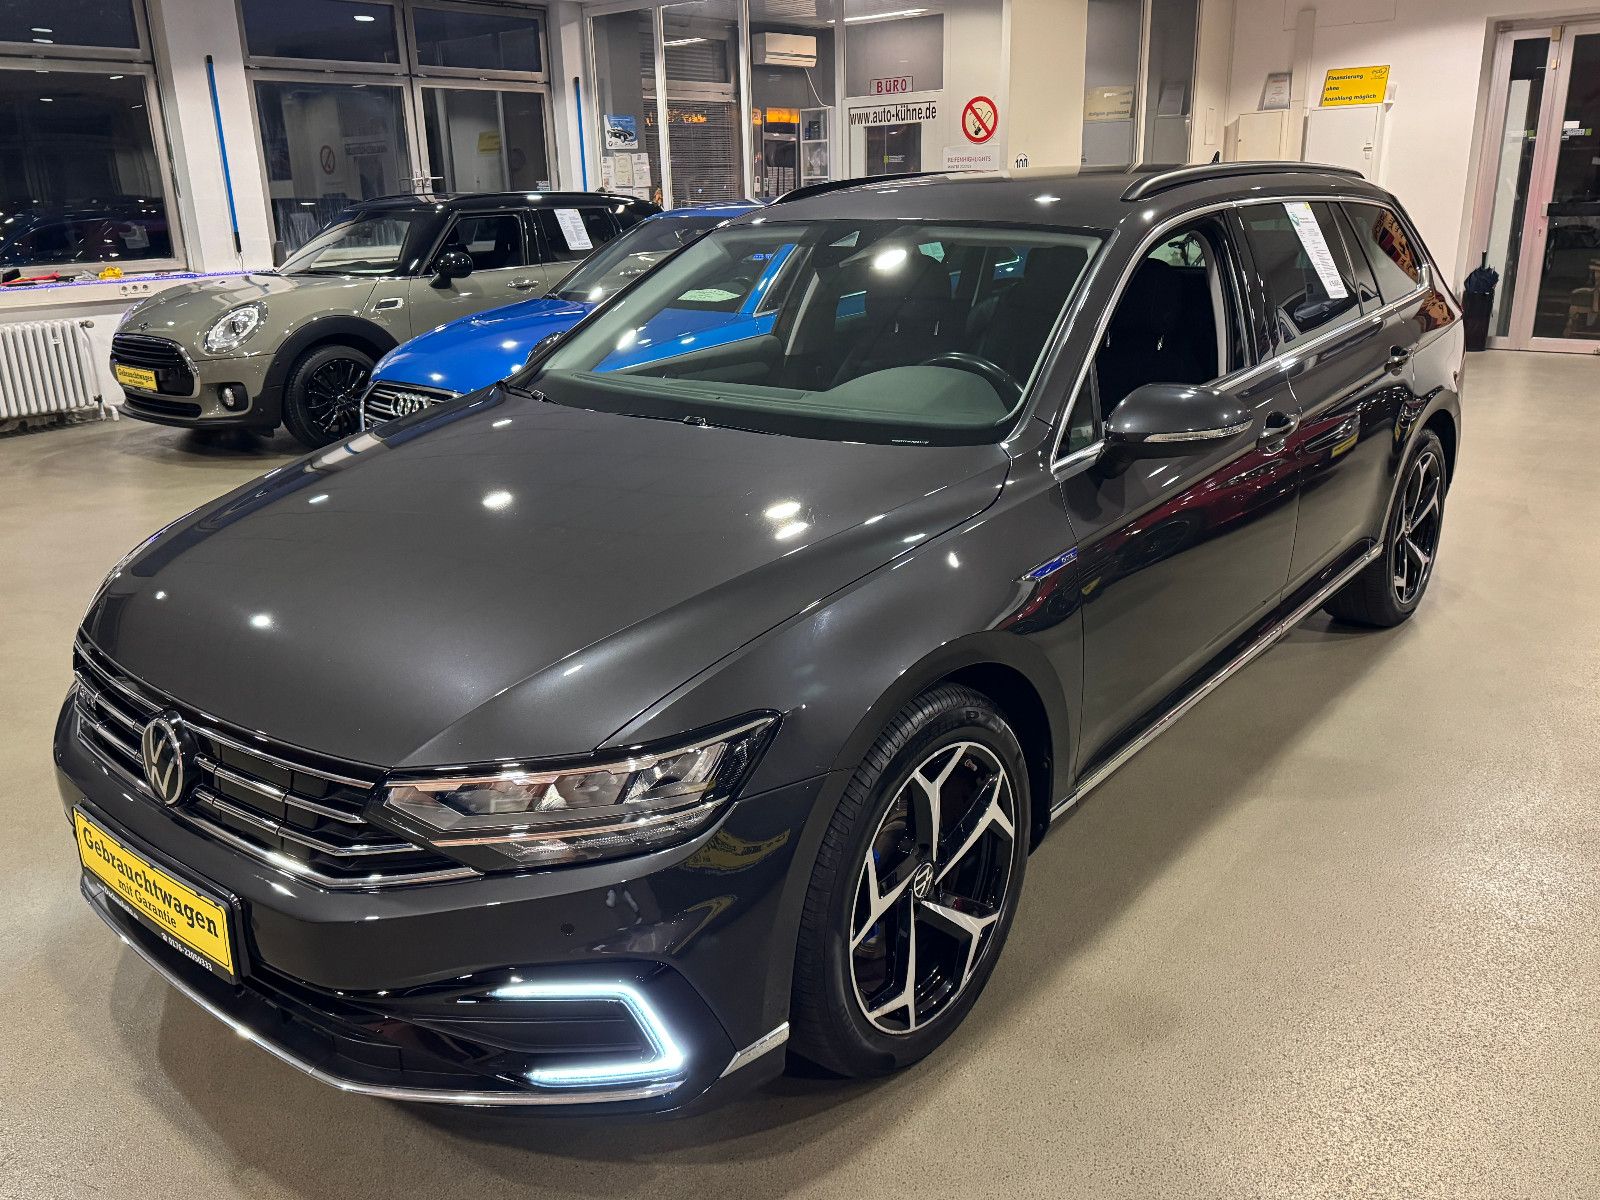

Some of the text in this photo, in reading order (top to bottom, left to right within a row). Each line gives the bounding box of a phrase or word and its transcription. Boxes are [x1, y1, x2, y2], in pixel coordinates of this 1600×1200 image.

[877, 78, 907, 93] BÜRO
[1328, 73, 1363, 81] Finanzierung
[1324, 93, 1377, 102] Anzahlung möglich
[850, 104, 937, 125] www.auto-kühne.de
[83, 826, 219, 938] Gebrauchtwagen
[118, 879, 134, 898] mit
[134, 889, 177, 928] Garantie
